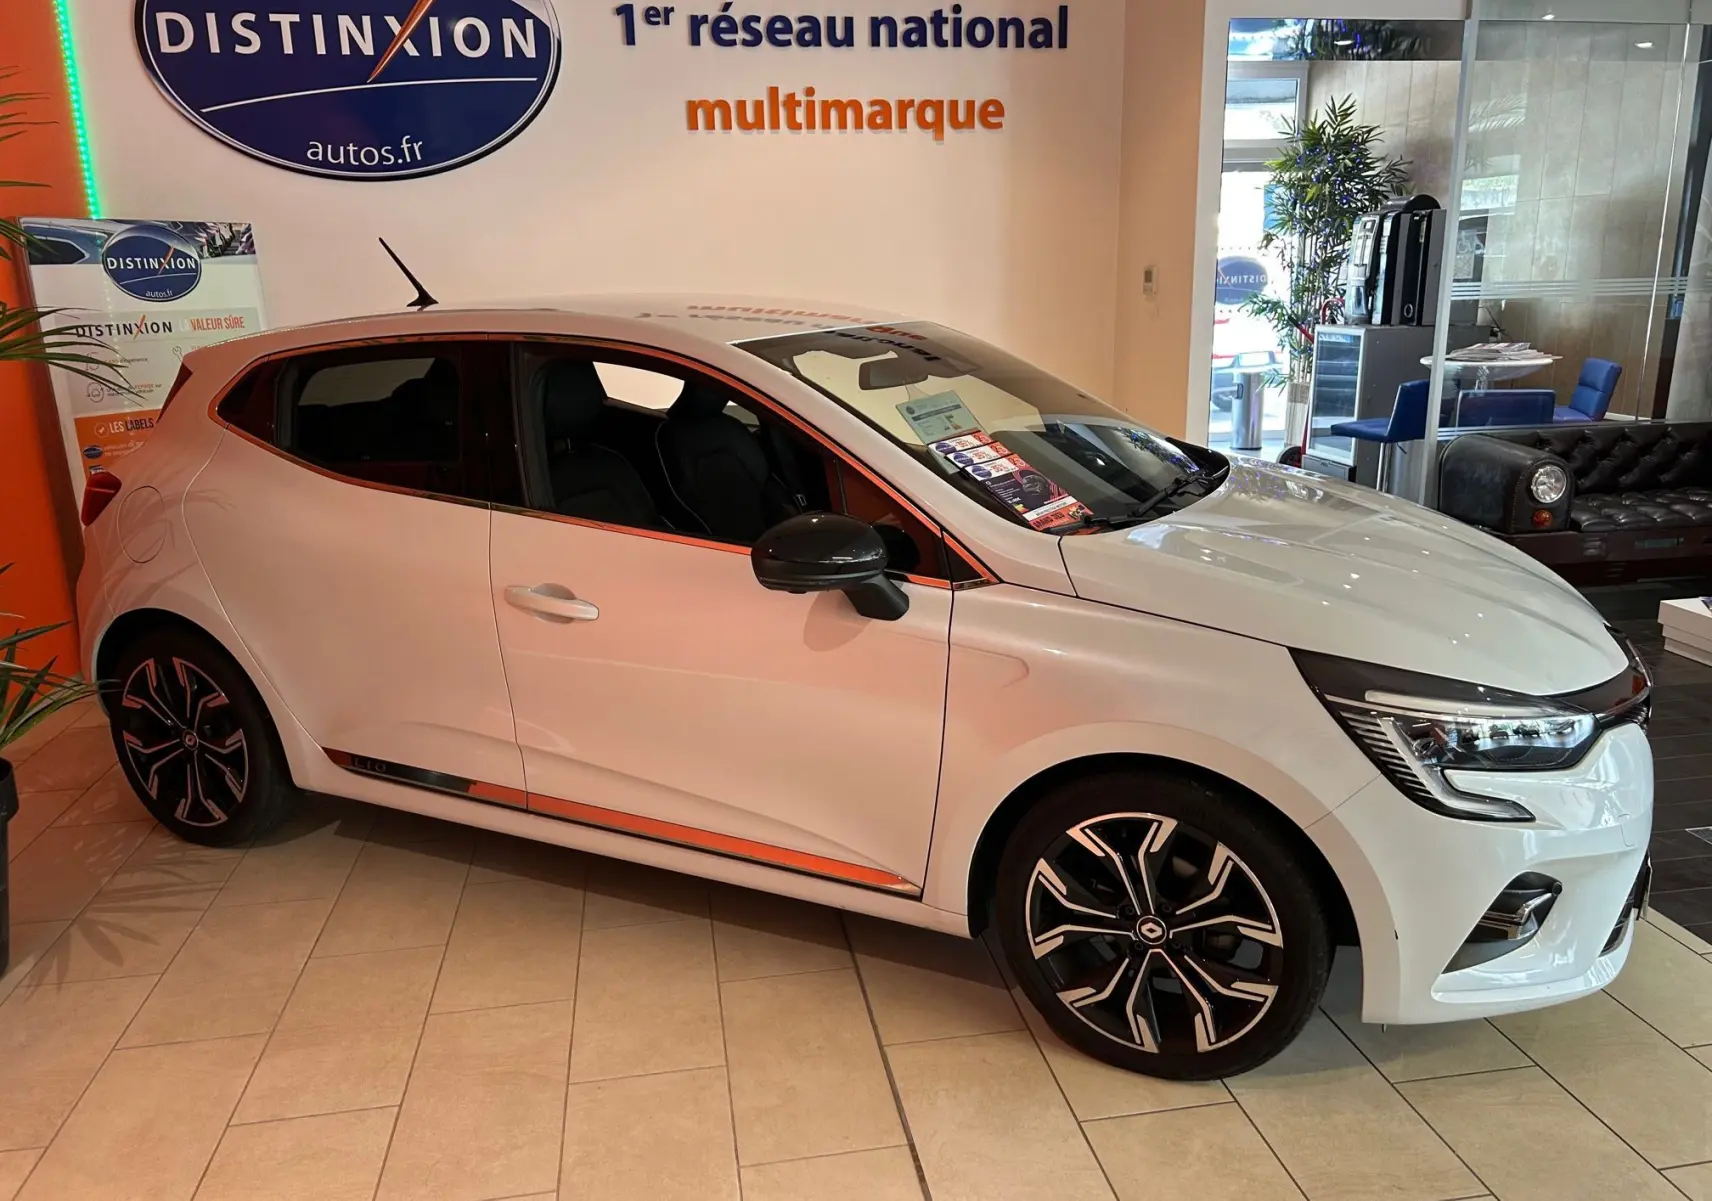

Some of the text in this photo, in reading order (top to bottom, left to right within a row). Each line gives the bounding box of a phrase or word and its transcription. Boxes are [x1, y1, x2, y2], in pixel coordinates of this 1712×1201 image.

[615, 1, 1069, 49] 1er réseau national
[155, 11, 538, 59] DISTINXION
[686, 86, 1006, 141] multimarque
[306, 135, 424, 166] autos.fr
[106, 256, 196, 270] DISTINXION
[145, 288, 173, 299] autos.fr
[76, 319, 173, 338] DISTINXION
[190, 316, 224, 332] VALEUR
[225, 314, 246, 329] SÛRE
[109, 417, 155, 434] LES LABELS
